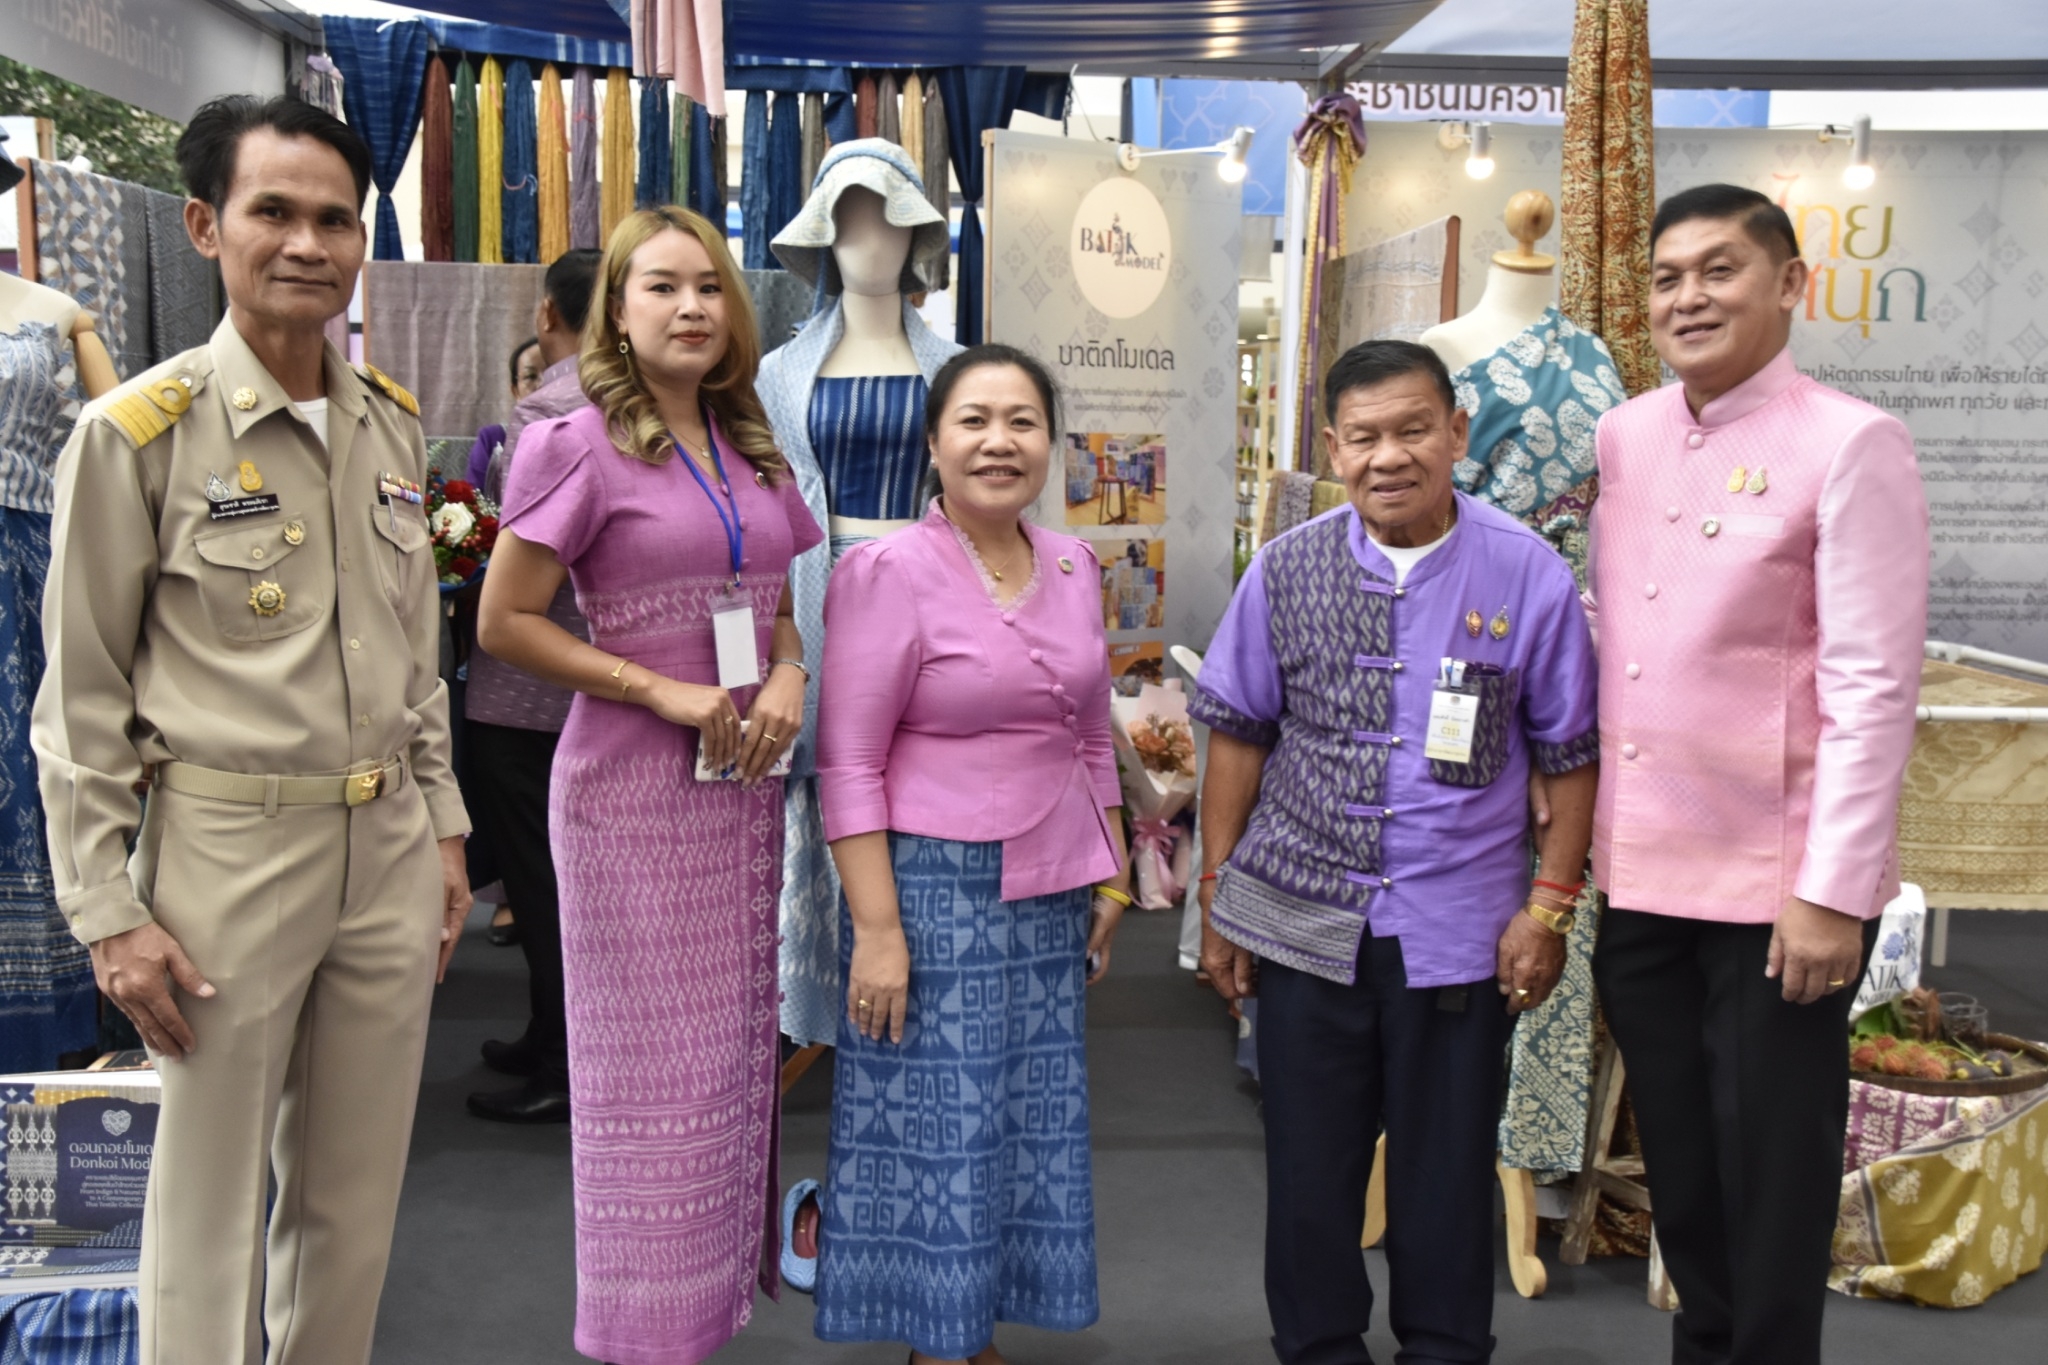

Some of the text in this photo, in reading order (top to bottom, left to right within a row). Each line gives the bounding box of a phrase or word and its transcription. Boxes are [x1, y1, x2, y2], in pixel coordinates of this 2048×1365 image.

[1058, 338, 1175, 370] บาติกโมเดล
[1960, 392, 2008, 416] ทุกวัย
[70, 1156, 151, 1170] Donkoi Mod
